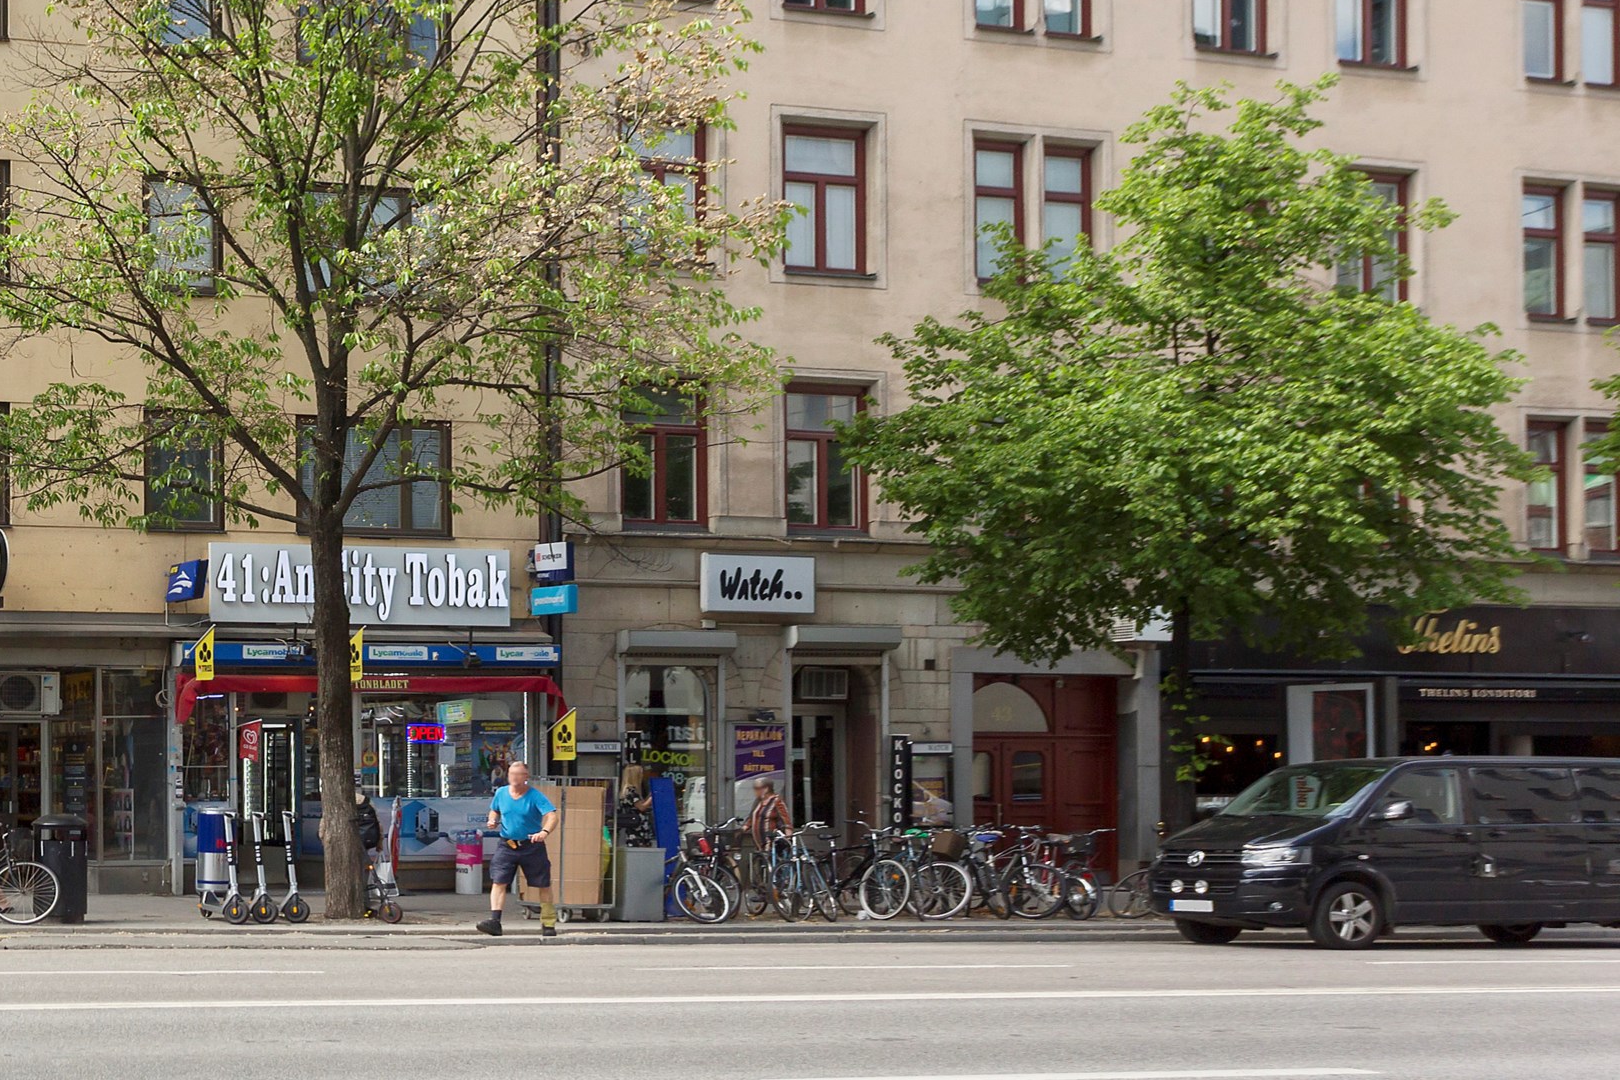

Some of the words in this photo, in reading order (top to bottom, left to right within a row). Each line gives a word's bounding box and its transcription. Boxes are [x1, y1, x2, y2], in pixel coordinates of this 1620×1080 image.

[404, 553, 508, 608] Tobak
[354, 679, 410, 690] TONBLADET
[1418, 688, 1470, 698] THELINS
[1472, 688, 1537, 698] KONDITORI
[409, 726, 443, 740] OPEN
